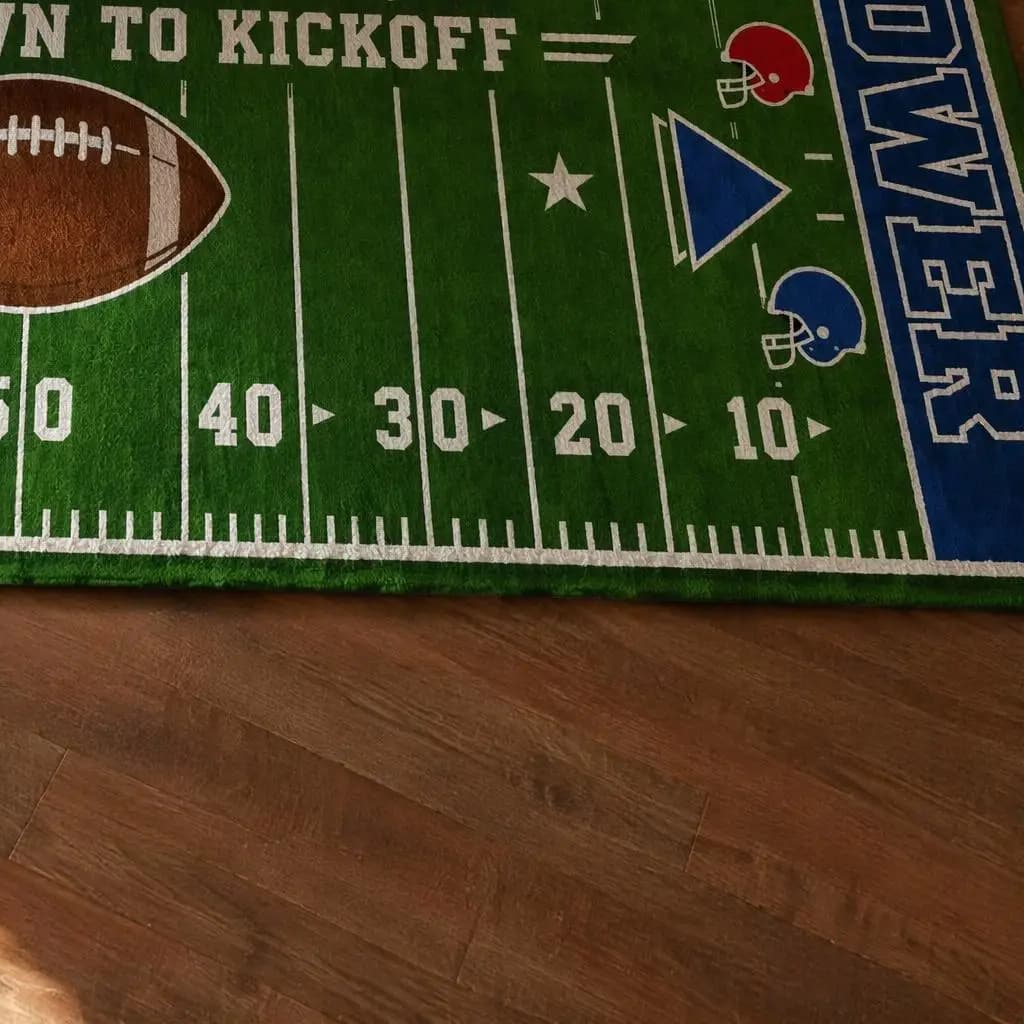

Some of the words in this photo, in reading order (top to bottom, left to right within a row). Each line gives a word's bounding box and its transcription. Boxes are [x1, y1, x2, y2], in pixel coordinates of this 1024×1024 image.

[100, 5, 188, 63] TO
[217, 8, 518, 73] KICKOFF
[198, 382, 282, 447] 40
[374, 387, 469, 453] 30
[550, 392, 636, 457] 20
[727, 397, 799, 461] 10
